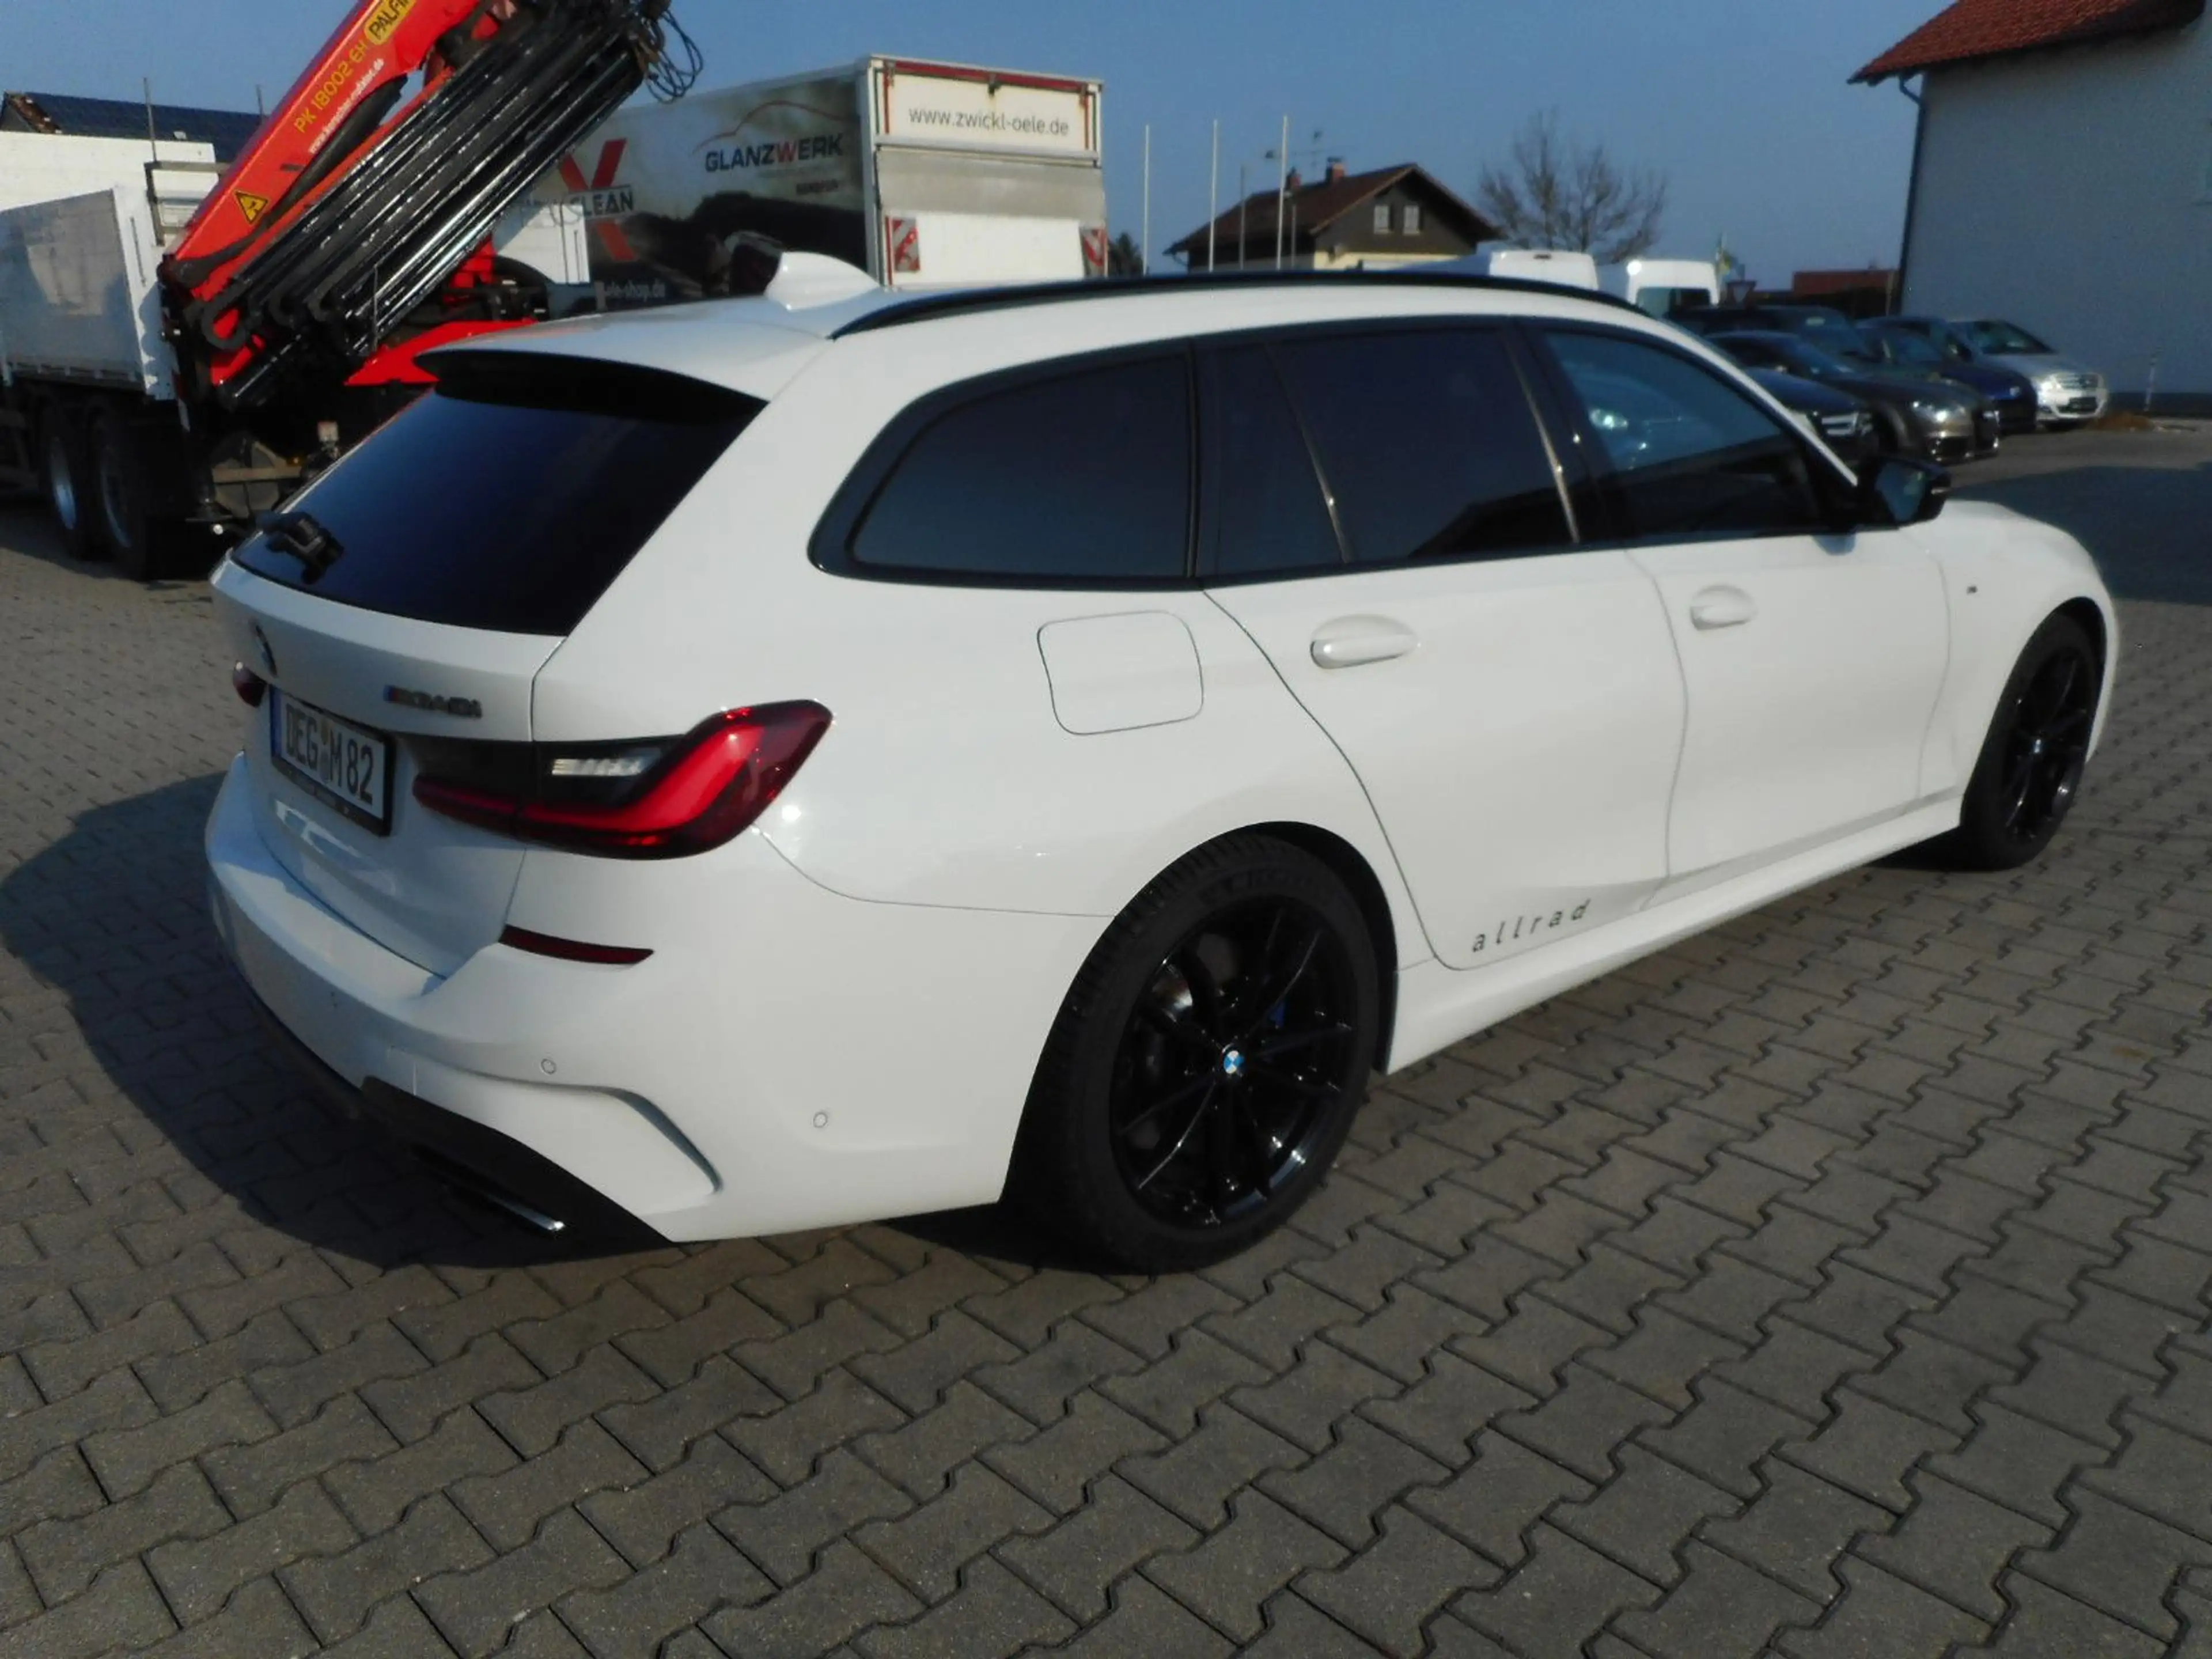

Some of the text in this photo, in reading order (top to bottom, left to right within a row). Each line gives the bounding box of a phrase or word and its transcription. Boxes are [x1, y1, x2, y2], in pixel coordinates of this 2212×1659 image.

[294, 108, 316, 133] PK
[909, 108, 1069, 136] www.zwickl-oele.de
[705, 134, 843, 172] GLANZWERK
[286, 702, 319, 770] DEG
[1471, 898, 1591, 953] allrad
